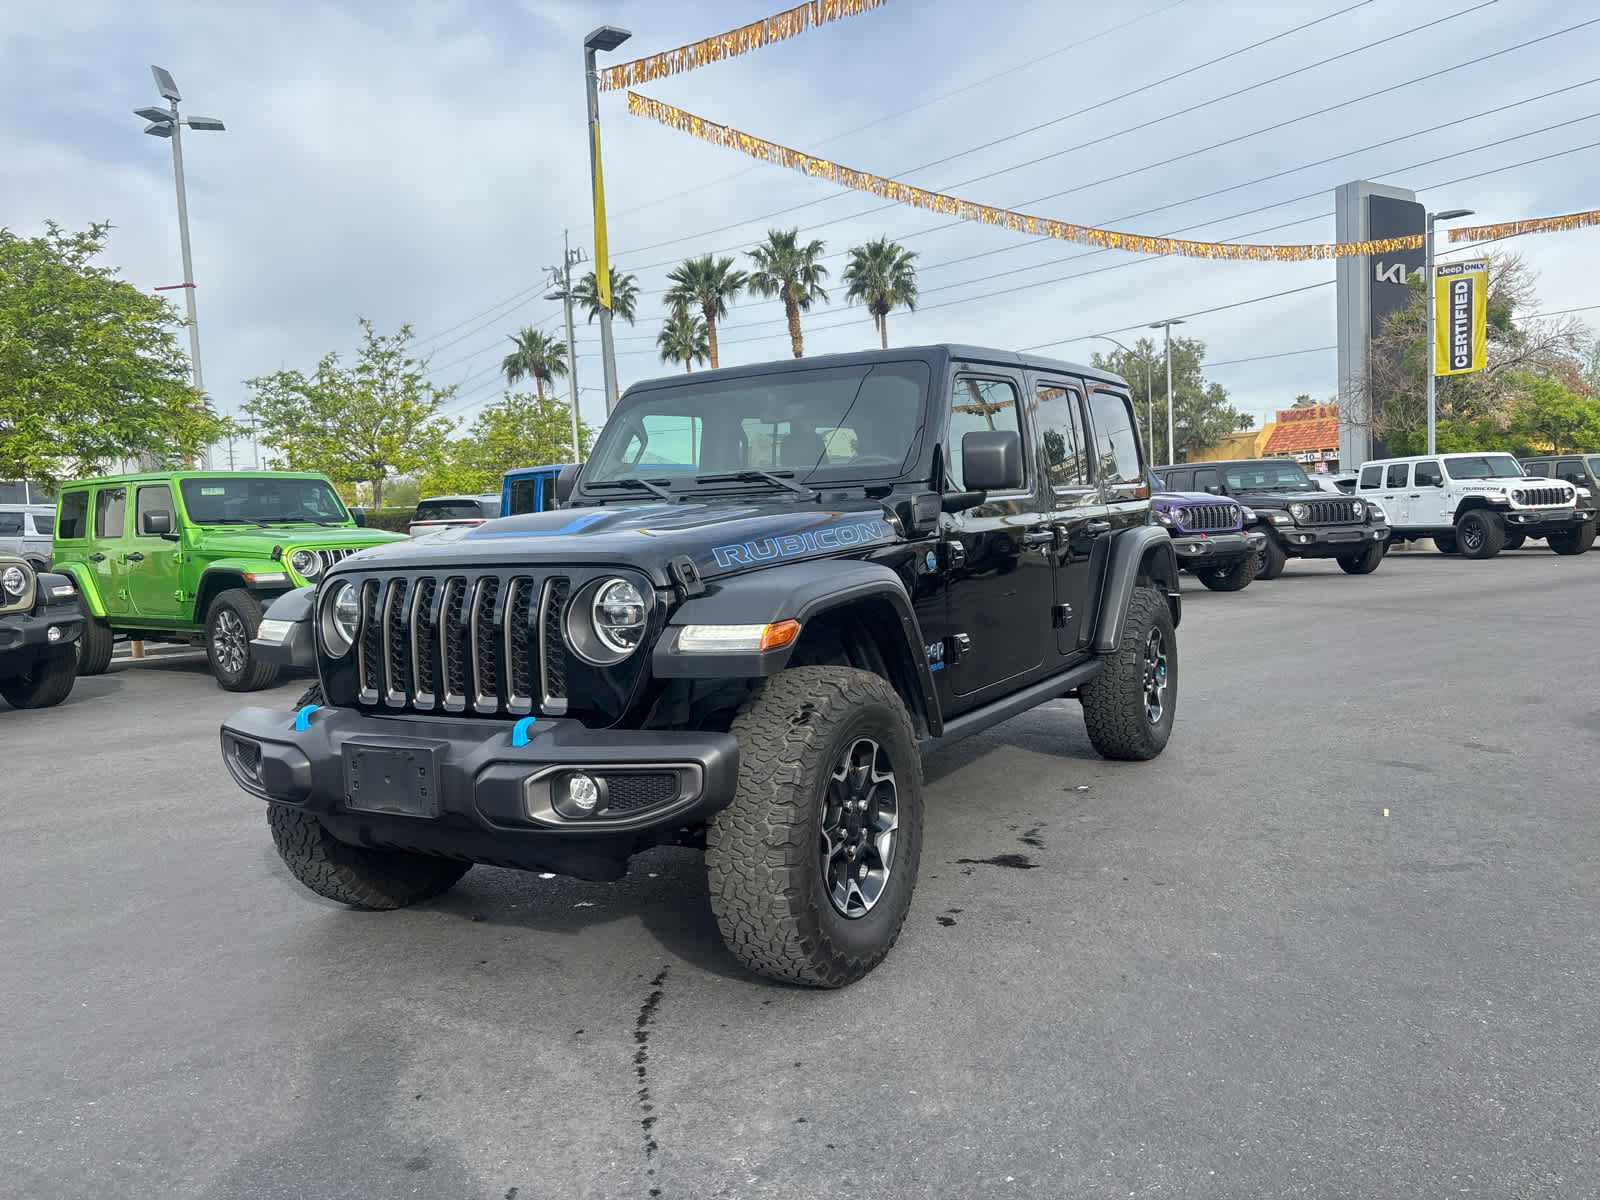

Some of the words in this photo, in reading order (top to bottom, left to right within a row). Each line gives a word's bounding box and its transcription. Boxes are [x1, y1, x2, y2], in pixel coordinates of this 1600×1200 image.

[1439, 265, 1463, 275] Jeep
[1464, 263, 1485, 271] ONLY
[1455, 281, 1468, 367] CERTIFIED
[1281, 408, 1315, 422] SMOKE
[712, 521, 883, 568] RUBICON
